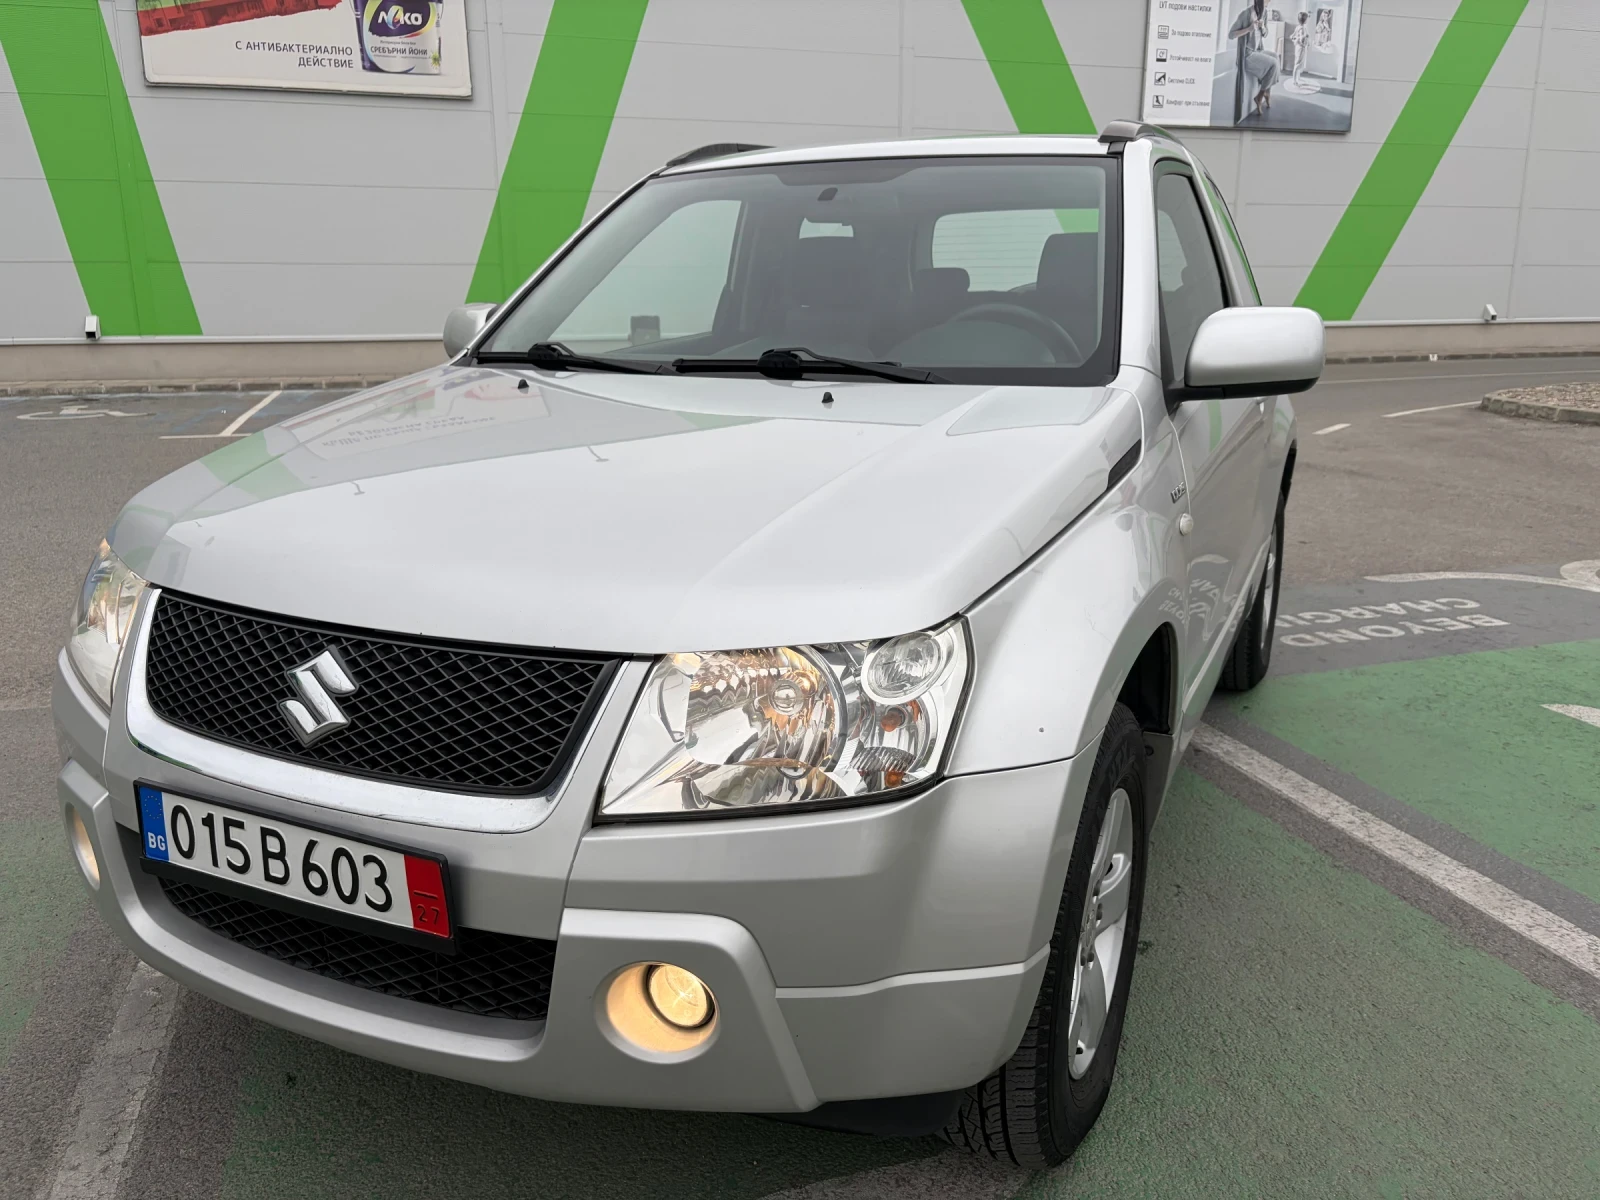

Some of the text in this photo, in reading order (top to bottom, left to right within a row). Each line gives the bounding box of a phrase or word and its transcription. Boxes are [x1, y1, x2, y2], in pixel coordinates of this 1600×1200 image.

[235, 40, 353, 56] С АНТИБАКТЕРИАЛНО
[370, 46, 407, 55] СРЕБЪРНИ
[408, 46, 428, 56] ЙОНИ
[298, 56, 354, 69] ДЕЙСТВИЕ
[1279, 614, 1511, 647] BEYOND
[147, 832, 166, 851] BG
[416, 903, 440, 926] 27
